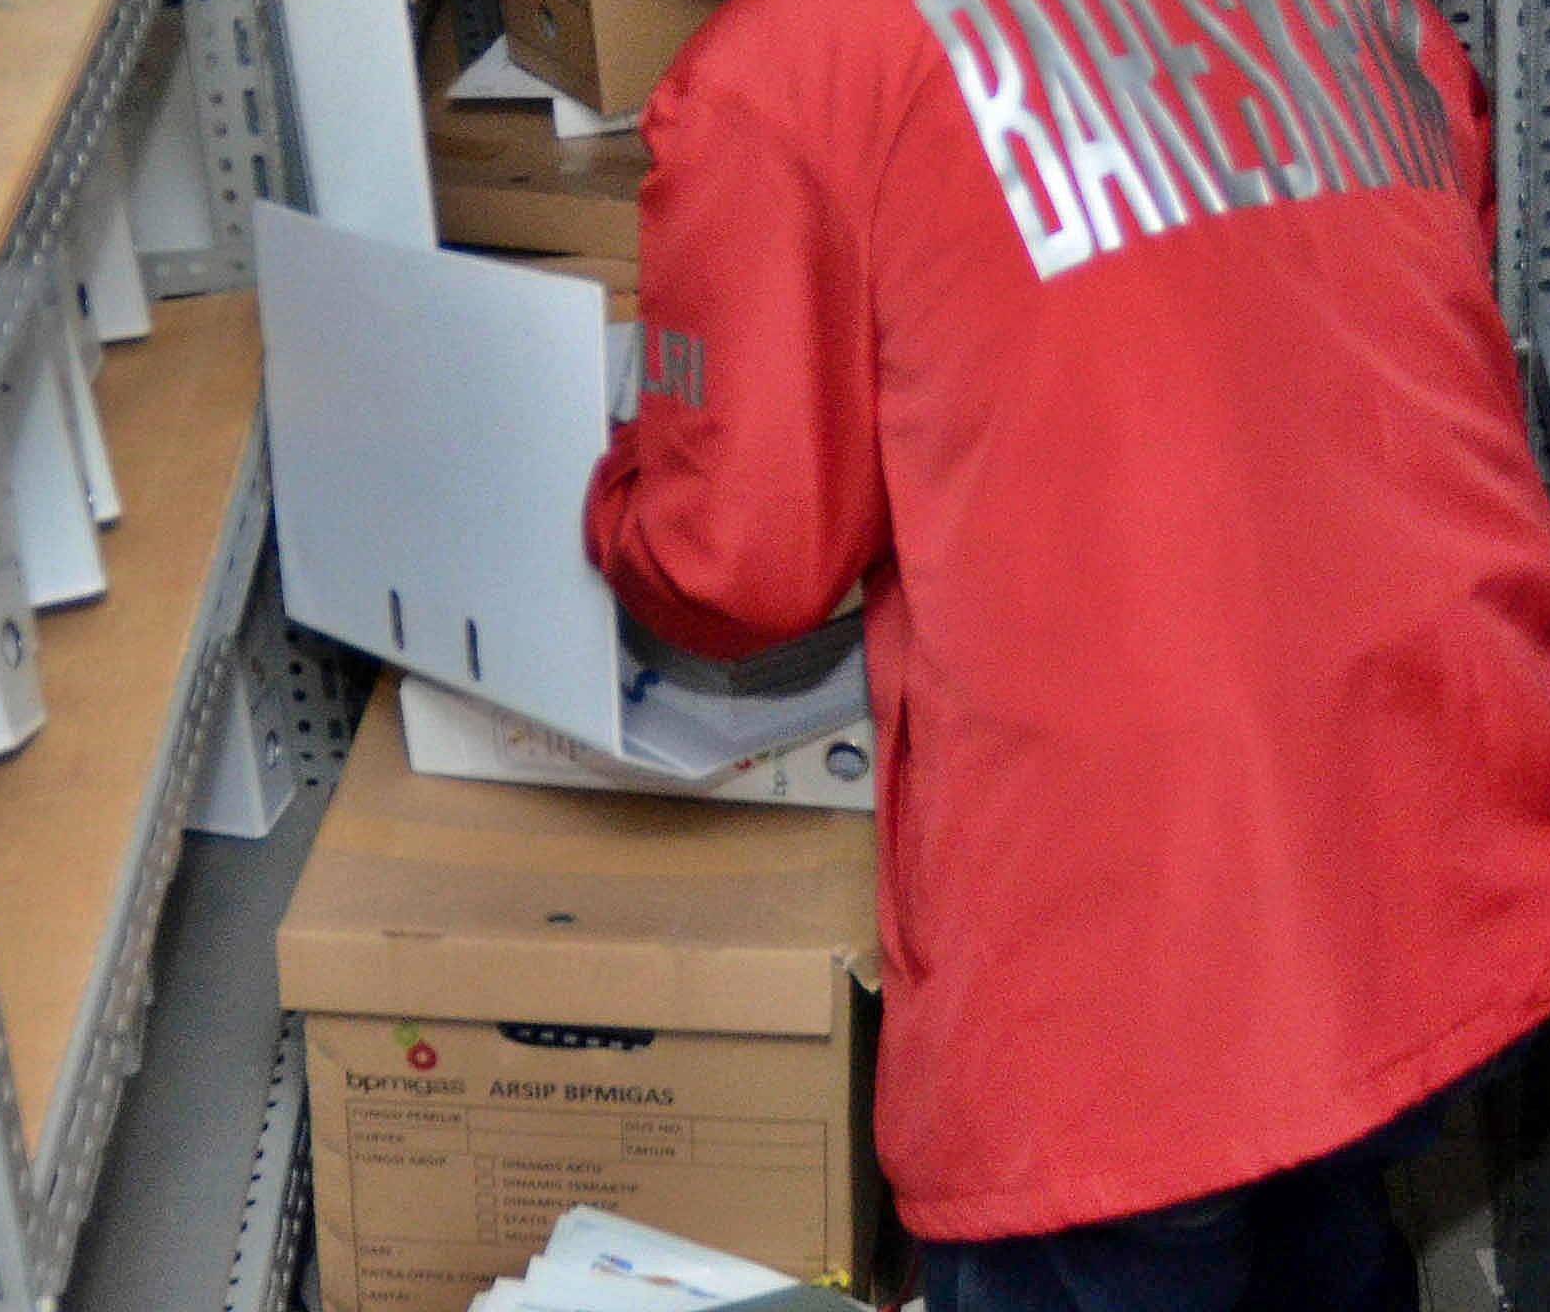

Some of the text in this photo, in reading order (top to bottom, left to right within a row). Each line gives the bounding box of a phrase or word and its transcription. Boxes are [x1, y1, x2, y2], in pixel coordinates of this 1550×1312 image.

[346, 1071, 465, 1096] bpmigas
[489, 1080, 675, 1106] ARSIP BPMIGAS
